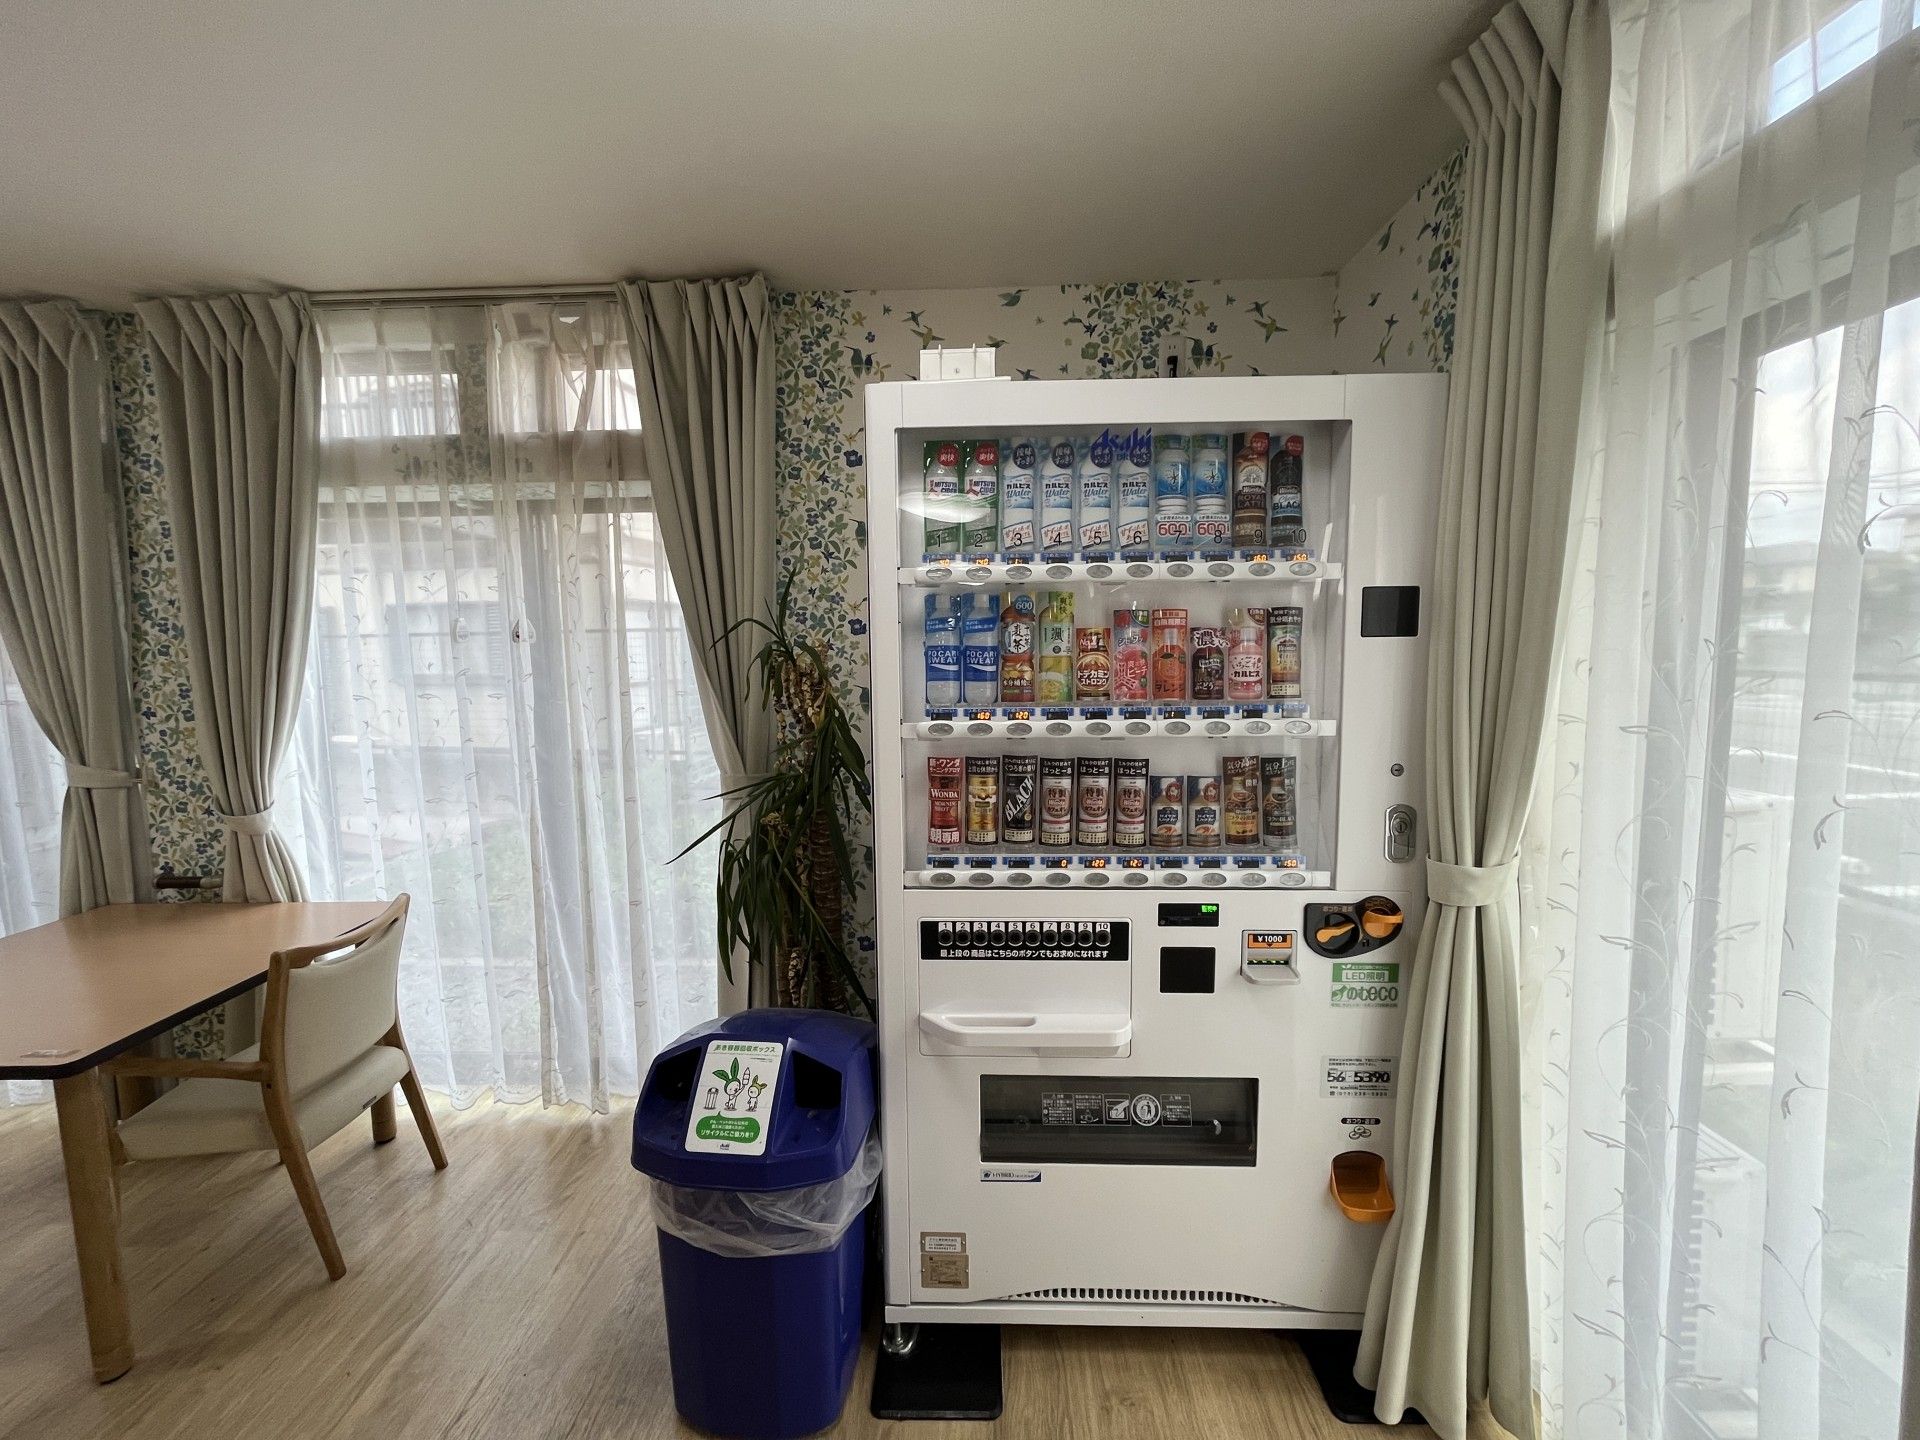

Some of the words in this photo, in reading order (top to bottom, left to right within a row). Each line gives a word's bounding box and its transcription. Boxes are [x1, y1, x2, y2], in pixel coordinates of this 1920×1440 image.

[1006, 489, 1031, 499] Water
[1045, 488, 1070, 498] Water
[1083, 488, 1108, 498] Water
[1122, 487, 1147, 497] Water
[974, 533, 983, 547] 2
[1013, 532, 1022, 546] 3
[1053, 532, 1062, 546] 4
[1093, 531, 1102, 545] 5
[1133, 531, 1142, 544] 6
[1173, 530, 1182, 544] 7
[1213, 529, 1222, 544] 8
[1254, 529, 1263, 543] 9
[1291, 528, 1306, 543] 10
[1015, 601, 1033, 610] 600
[931, 788, 958, 798] WONDA
[1005, 775, 1034, 821] BLACK
[930, 828, 960, 843] 朝専用
[1345, 971, 1386, 981] LED照明
